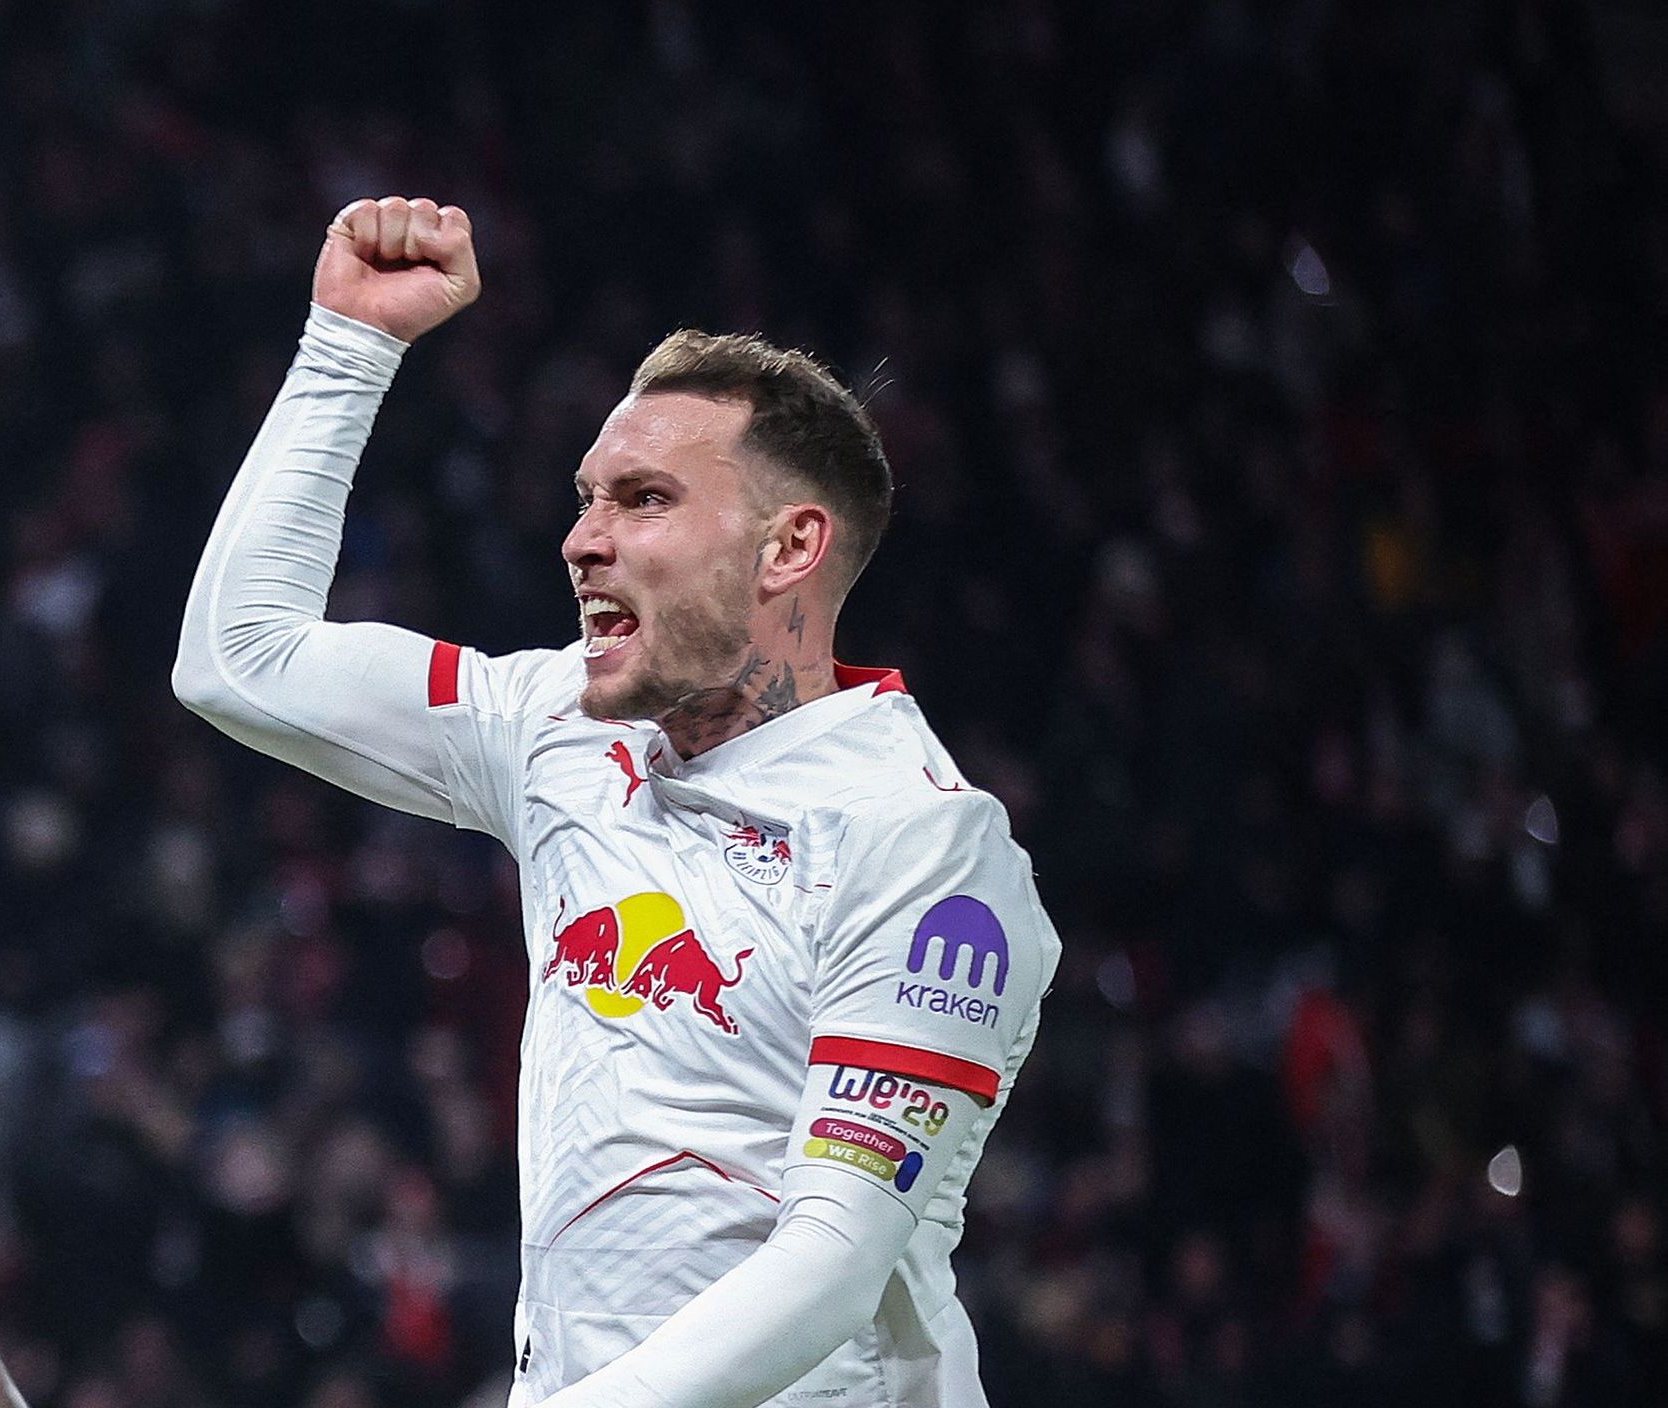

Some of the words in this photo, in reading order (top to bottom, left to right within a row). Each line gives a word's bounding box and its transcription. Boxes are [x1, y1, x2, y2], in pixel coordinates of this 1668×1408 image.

[895, 981, 1000, 1029] kraken
[825, 1122, 894, 1154] Together
[828, 1144, 856, 1161] WE
[857, 1154, 888, 1176] Rise
